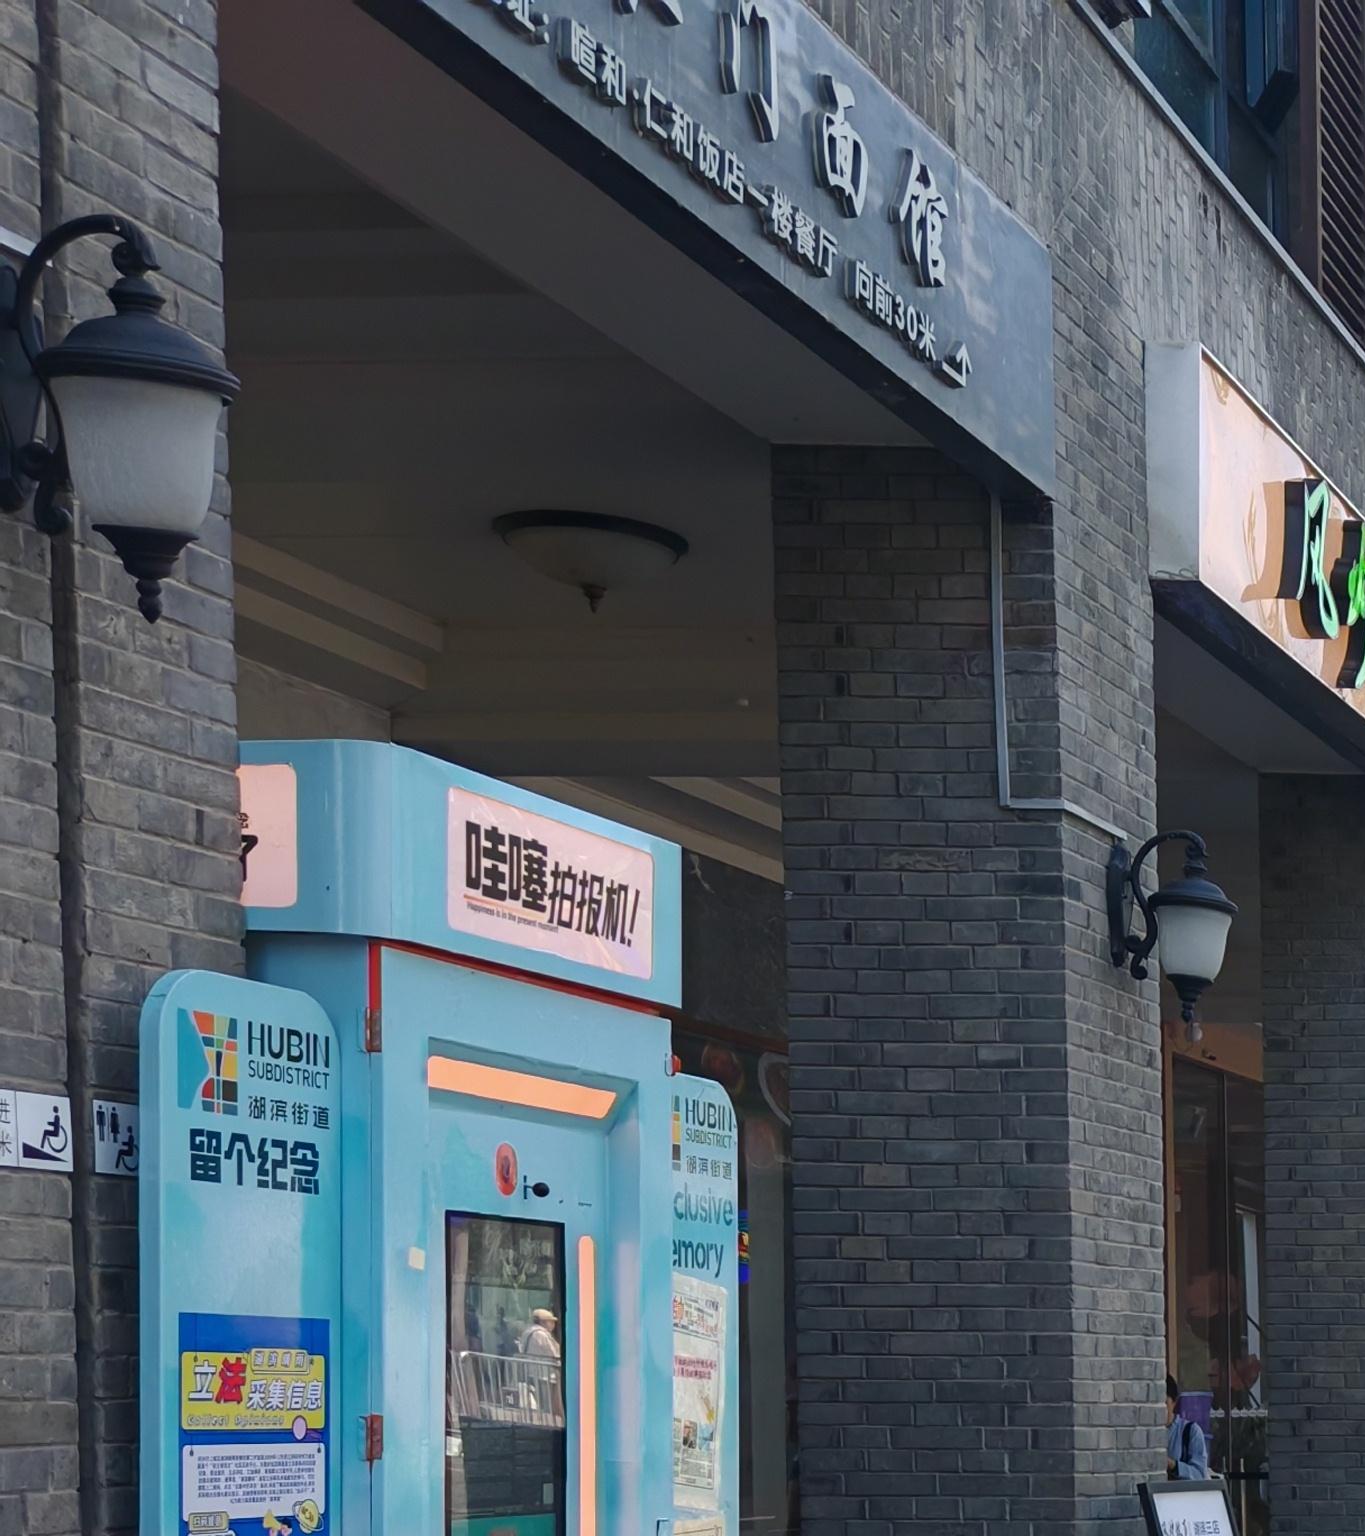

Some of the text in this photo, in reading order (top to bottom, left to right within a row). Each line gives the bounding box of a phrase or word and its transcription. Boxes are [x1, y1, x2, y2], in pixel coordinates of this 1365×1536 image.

[613, 0, 949, 287] 门面馆
[856, 259, 937, 361] 向前30米
[247, 1021, 330, 1069] HUBIN
[247, 1060, 330, 1091] SUBDISTRICT
[247, 1096, 331, 1130] 湖滨街道
[685, 1097, 733, 1133] HUBIN
[685, 1127, 733, 1150] SUBDISTRICT
[190, 1127, 320, 1196] 留个纪念
[686, 1154, 733, 1181] 湖滨街道
